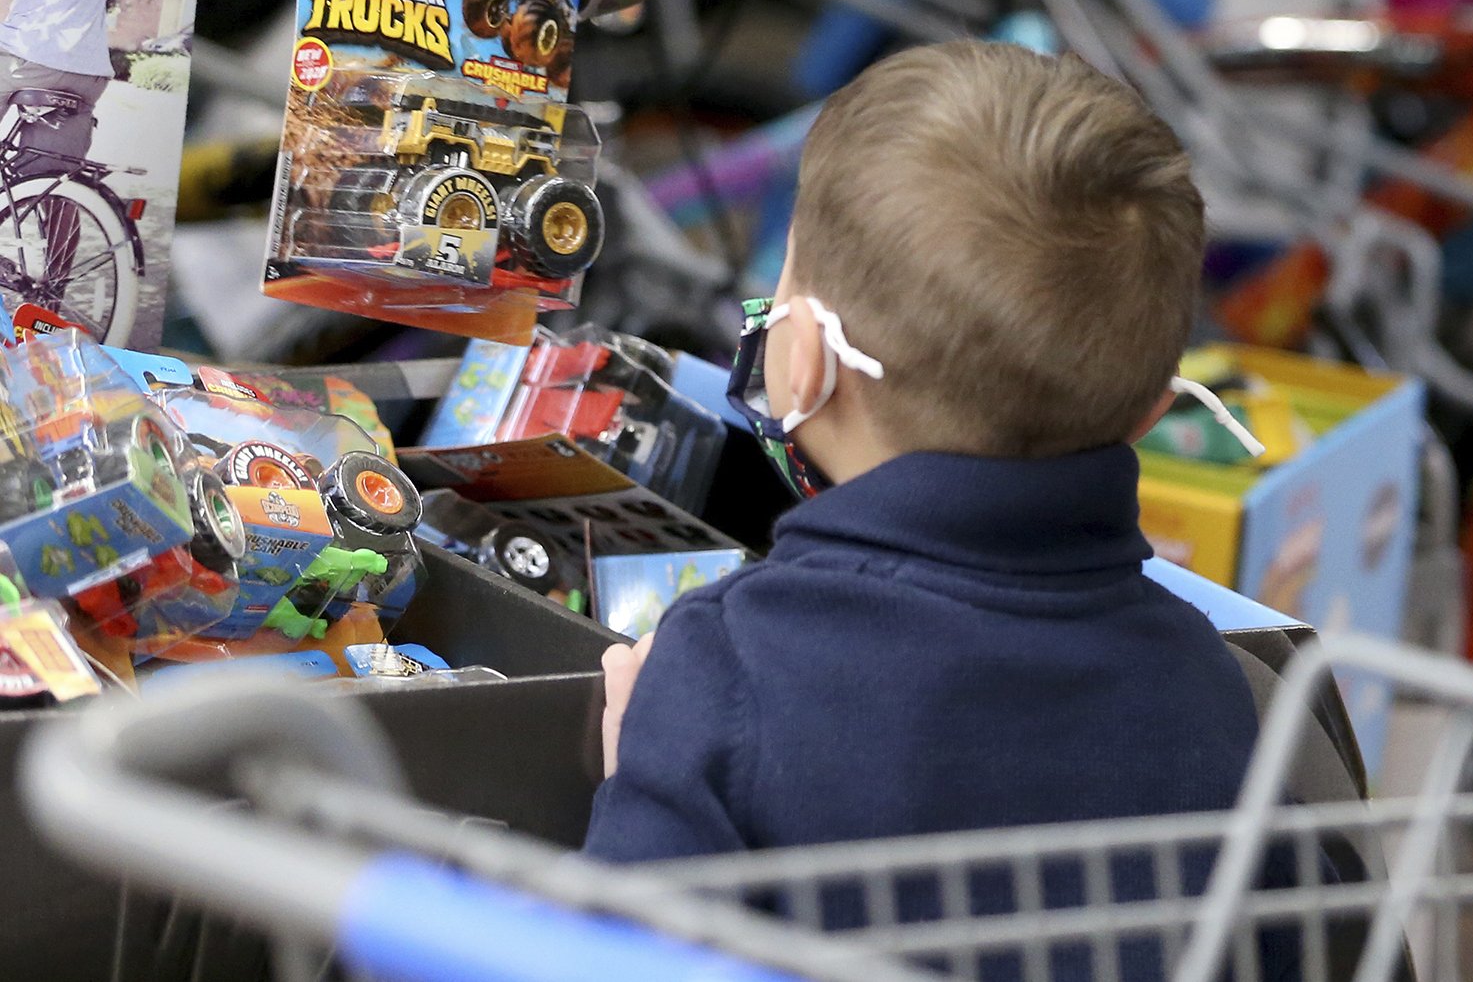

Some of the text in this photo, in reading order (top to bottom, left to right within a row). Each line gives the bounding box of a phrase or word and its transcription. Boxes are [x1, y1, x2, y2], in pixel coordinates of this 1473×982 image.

[462, 60, 548, 92] CRUSHABLE
[424, 179, 454, 218] GIANT
[436, 233, 460, 264] 5
[235, 445, 309, 482] GIANT WHEELS!
